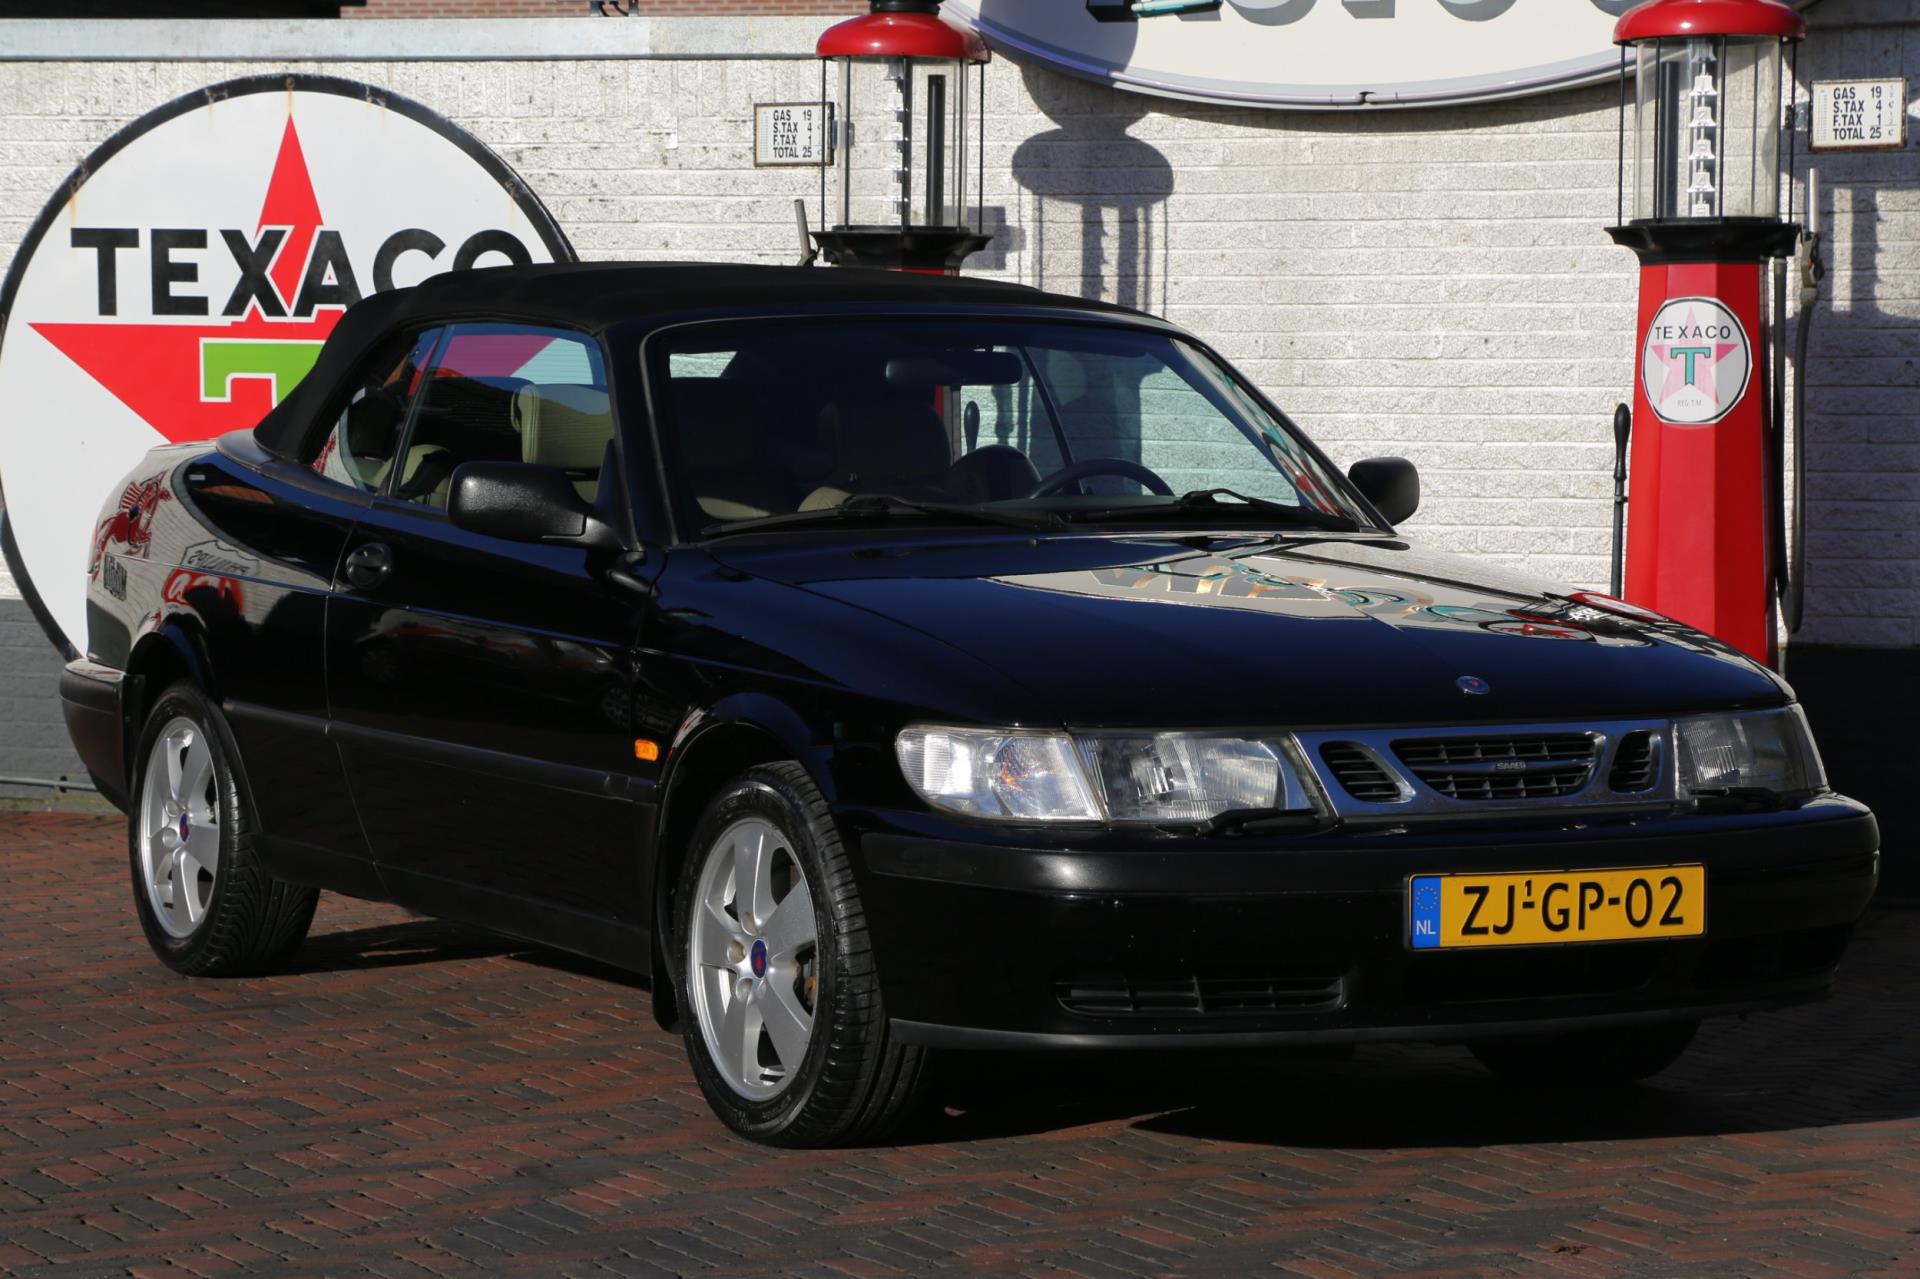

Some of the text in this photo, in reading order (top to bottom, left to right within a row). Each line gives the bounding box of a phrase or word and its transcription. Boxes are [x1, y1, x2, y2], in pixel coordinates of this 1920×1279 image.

[1833, 86, 1882, 99] GAS 19
[1833, 100, 1882, 113] S.TAX 4
[773, 110, 812, 121] GAS 19
[1833, 114, 1882, 126] F.TAX 1
[773, 122, 812, 134] S.TAX 4
[1833, 127, 1882, 140] TOTAL 25
[773, 135, 797, 146] F.TAX
[773, 146, 812, 158] TOTAL 25
[1655, 325, 1731, 340] TEXACO
[1670, 346, 1711, 386] T
[1416, 919, 1436, 935] NL
